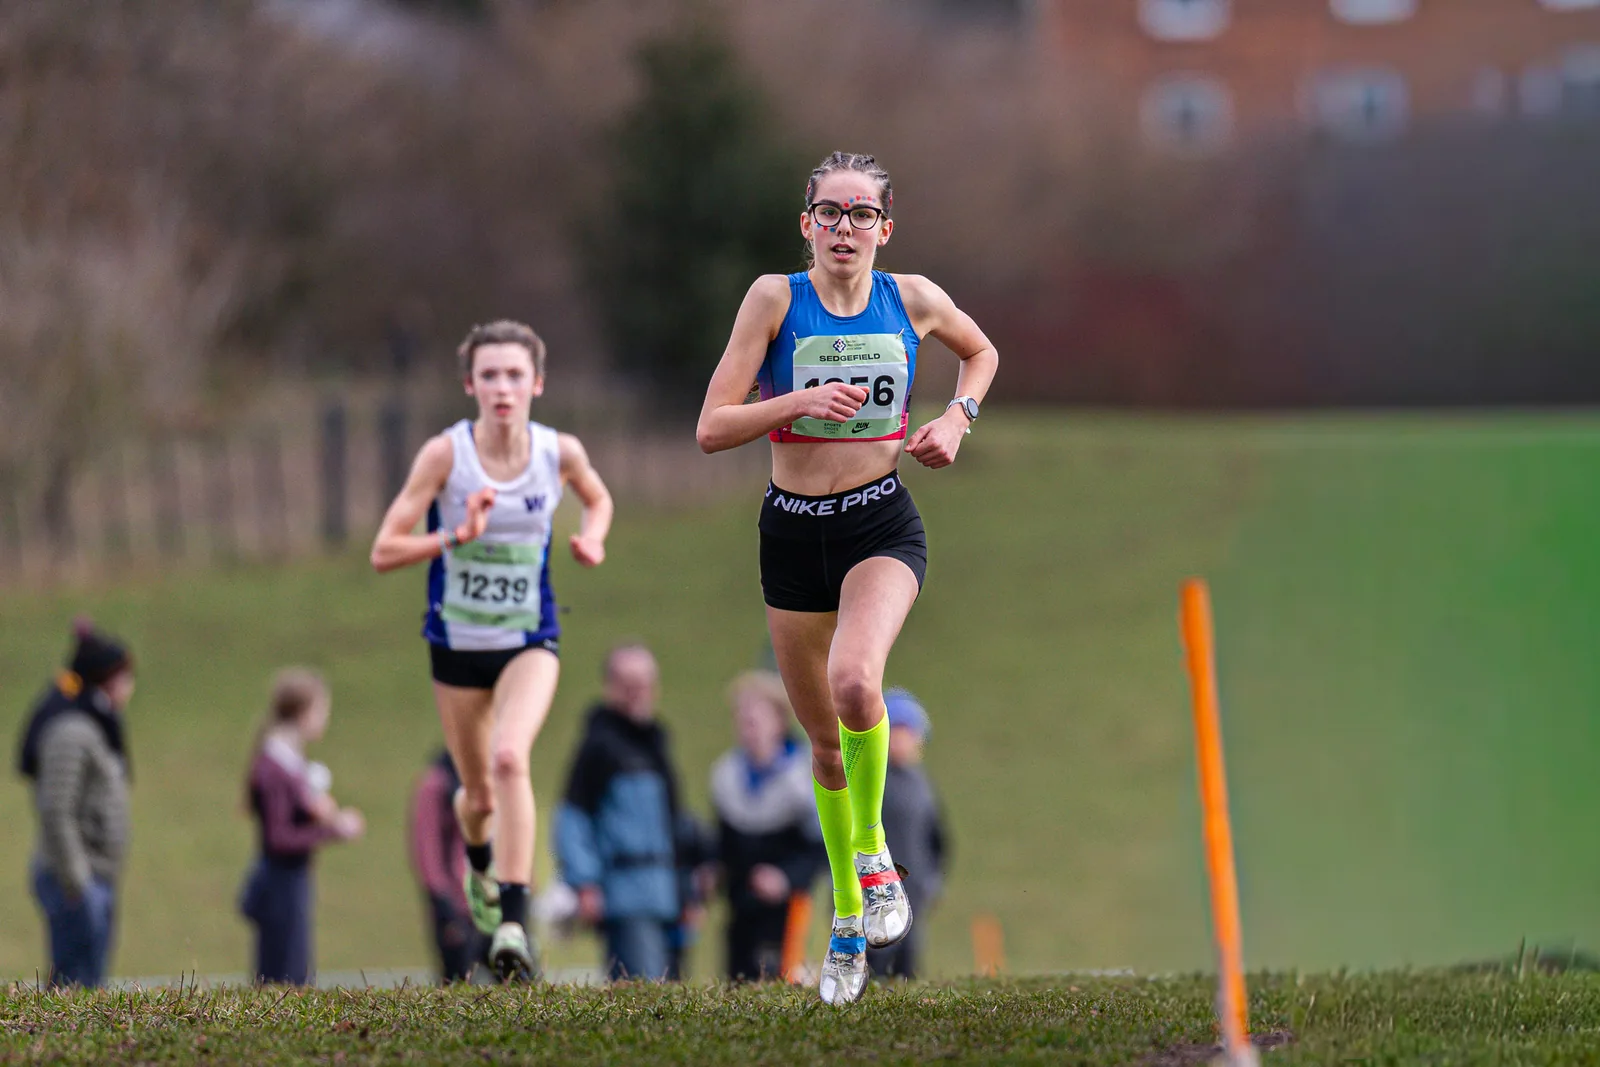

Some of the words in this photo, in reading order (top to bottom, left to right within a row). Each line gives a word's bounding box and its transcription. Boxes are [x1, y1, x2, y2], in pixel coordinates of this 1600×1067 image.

[819, 353, 881, 362] SEDGEFIELD
[805, 375, 895, 407] 56
[524, 496, 546, 512] W
[773, 494, 837, 516] NIKE
[841, 477, 897, 512] PRO
[458, 570, 529, 604] 1239
